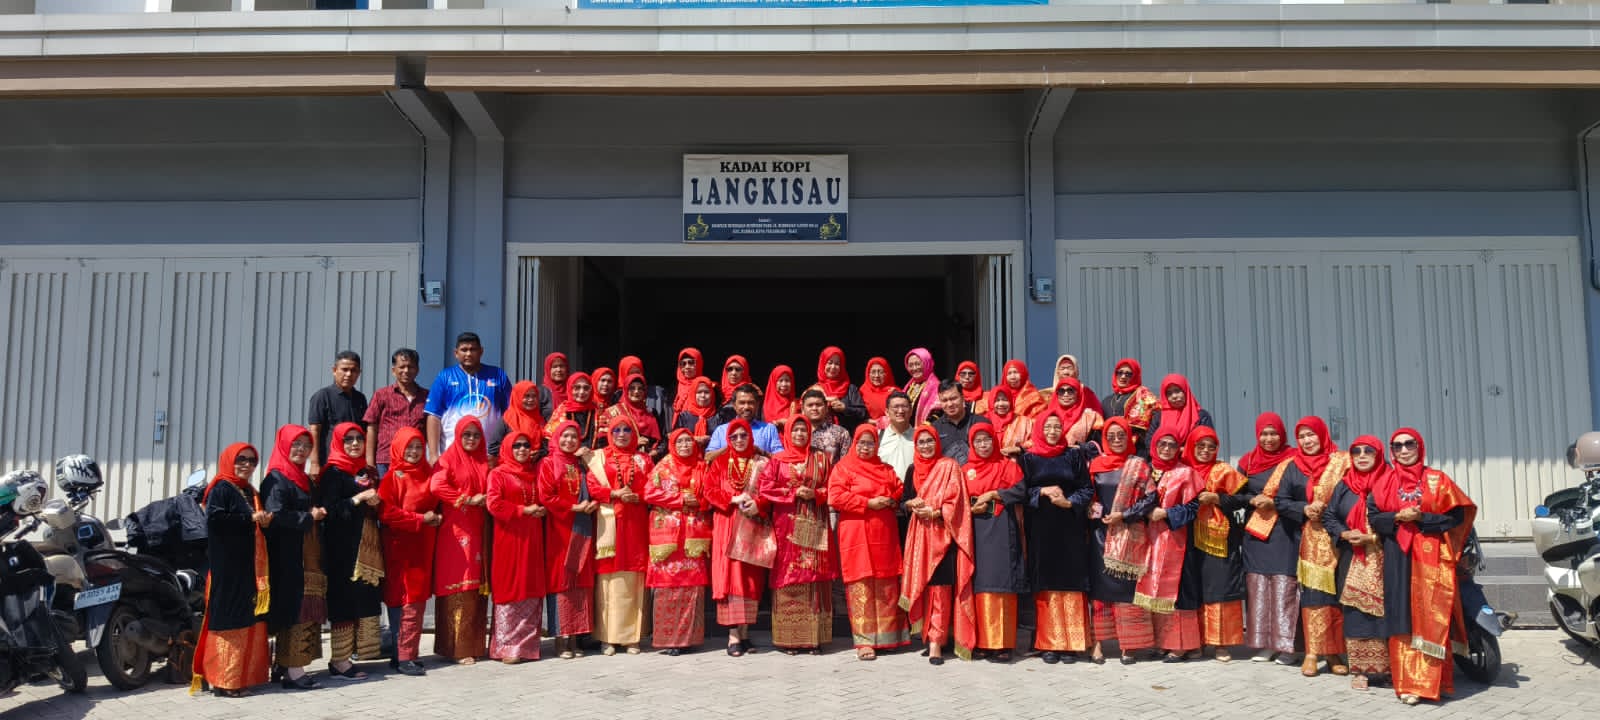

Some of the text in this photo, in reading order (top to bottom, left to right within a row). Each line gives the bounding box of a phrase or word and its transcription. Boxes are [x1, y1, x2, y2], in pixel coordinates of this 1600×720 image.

[720, 161, 811, 173] KADAI KOPI
[690, 177, 841, 205] LANGKISAU
